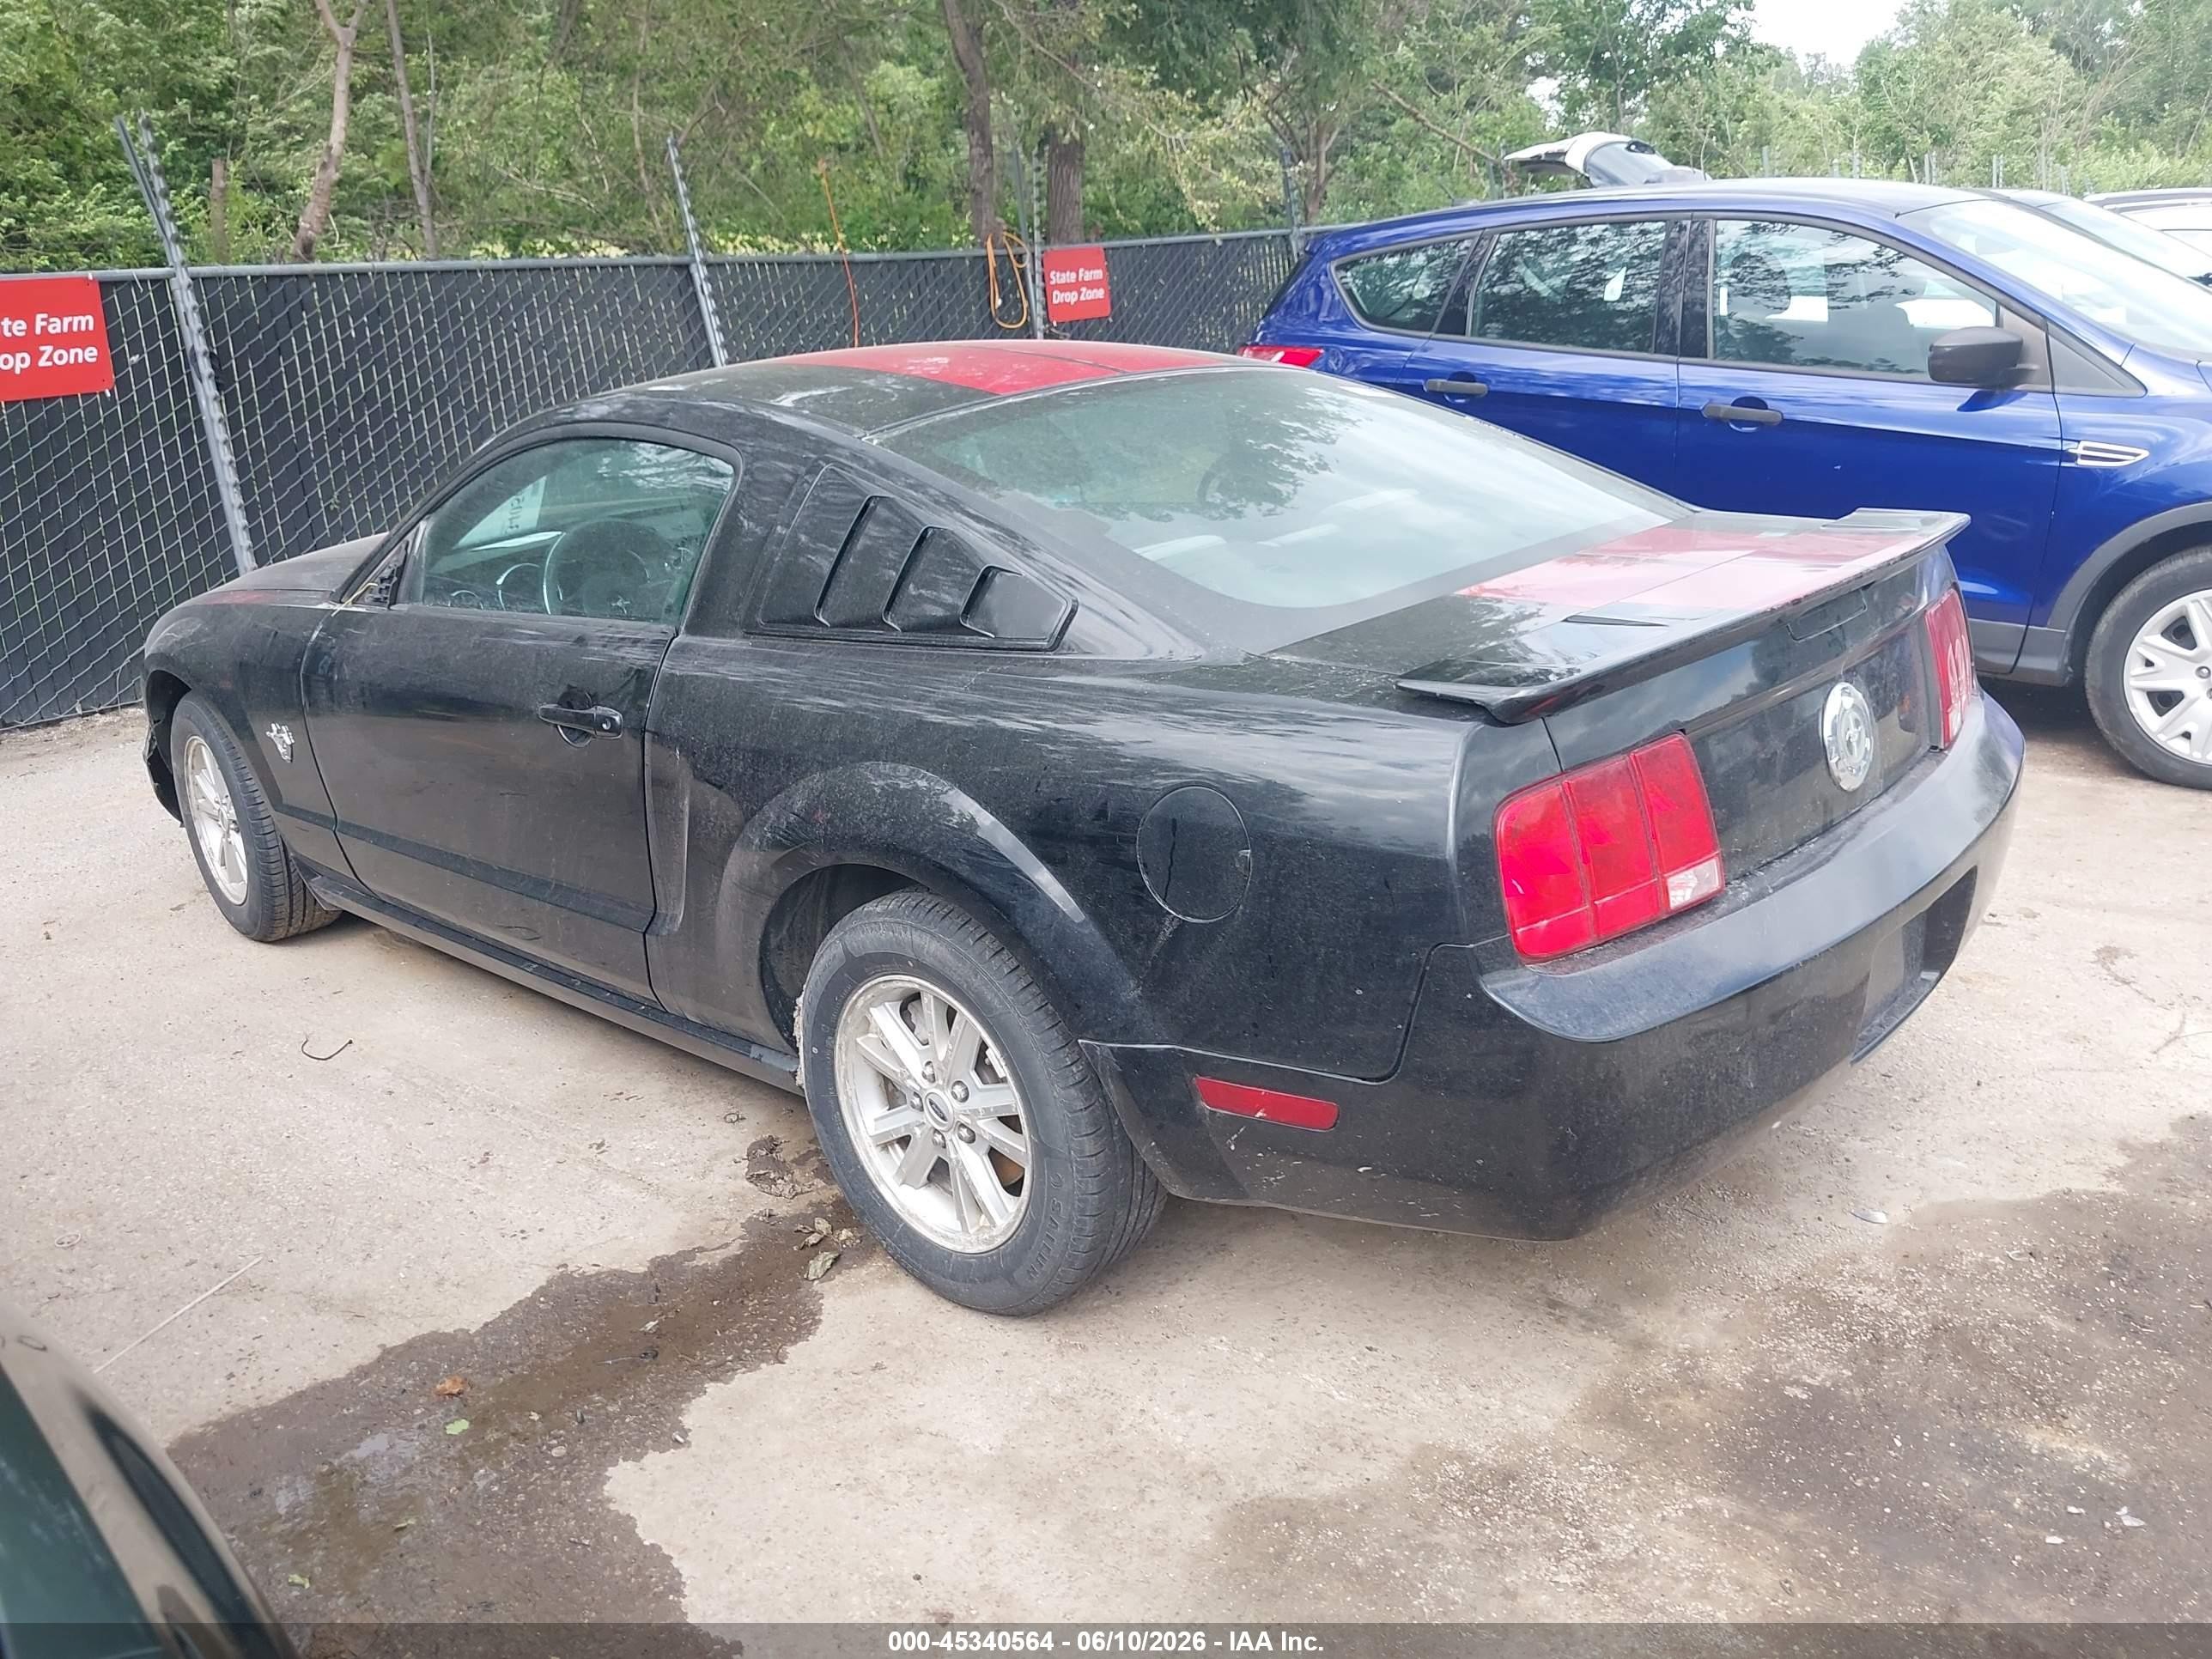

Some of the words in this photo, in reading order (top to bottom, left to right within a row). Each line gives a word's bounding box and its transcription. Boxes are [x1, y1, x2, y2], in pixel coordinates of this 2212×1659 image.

[1049, 270, 1076, 285] State
[1079, 267, 1103, 282] Farm
[1052, 289, 1078, 306] Drop
[1079, 286, 1104, 301] Zone
[35, 313, 94, 335] Farm
[38, 345, 98, 368] Zone
